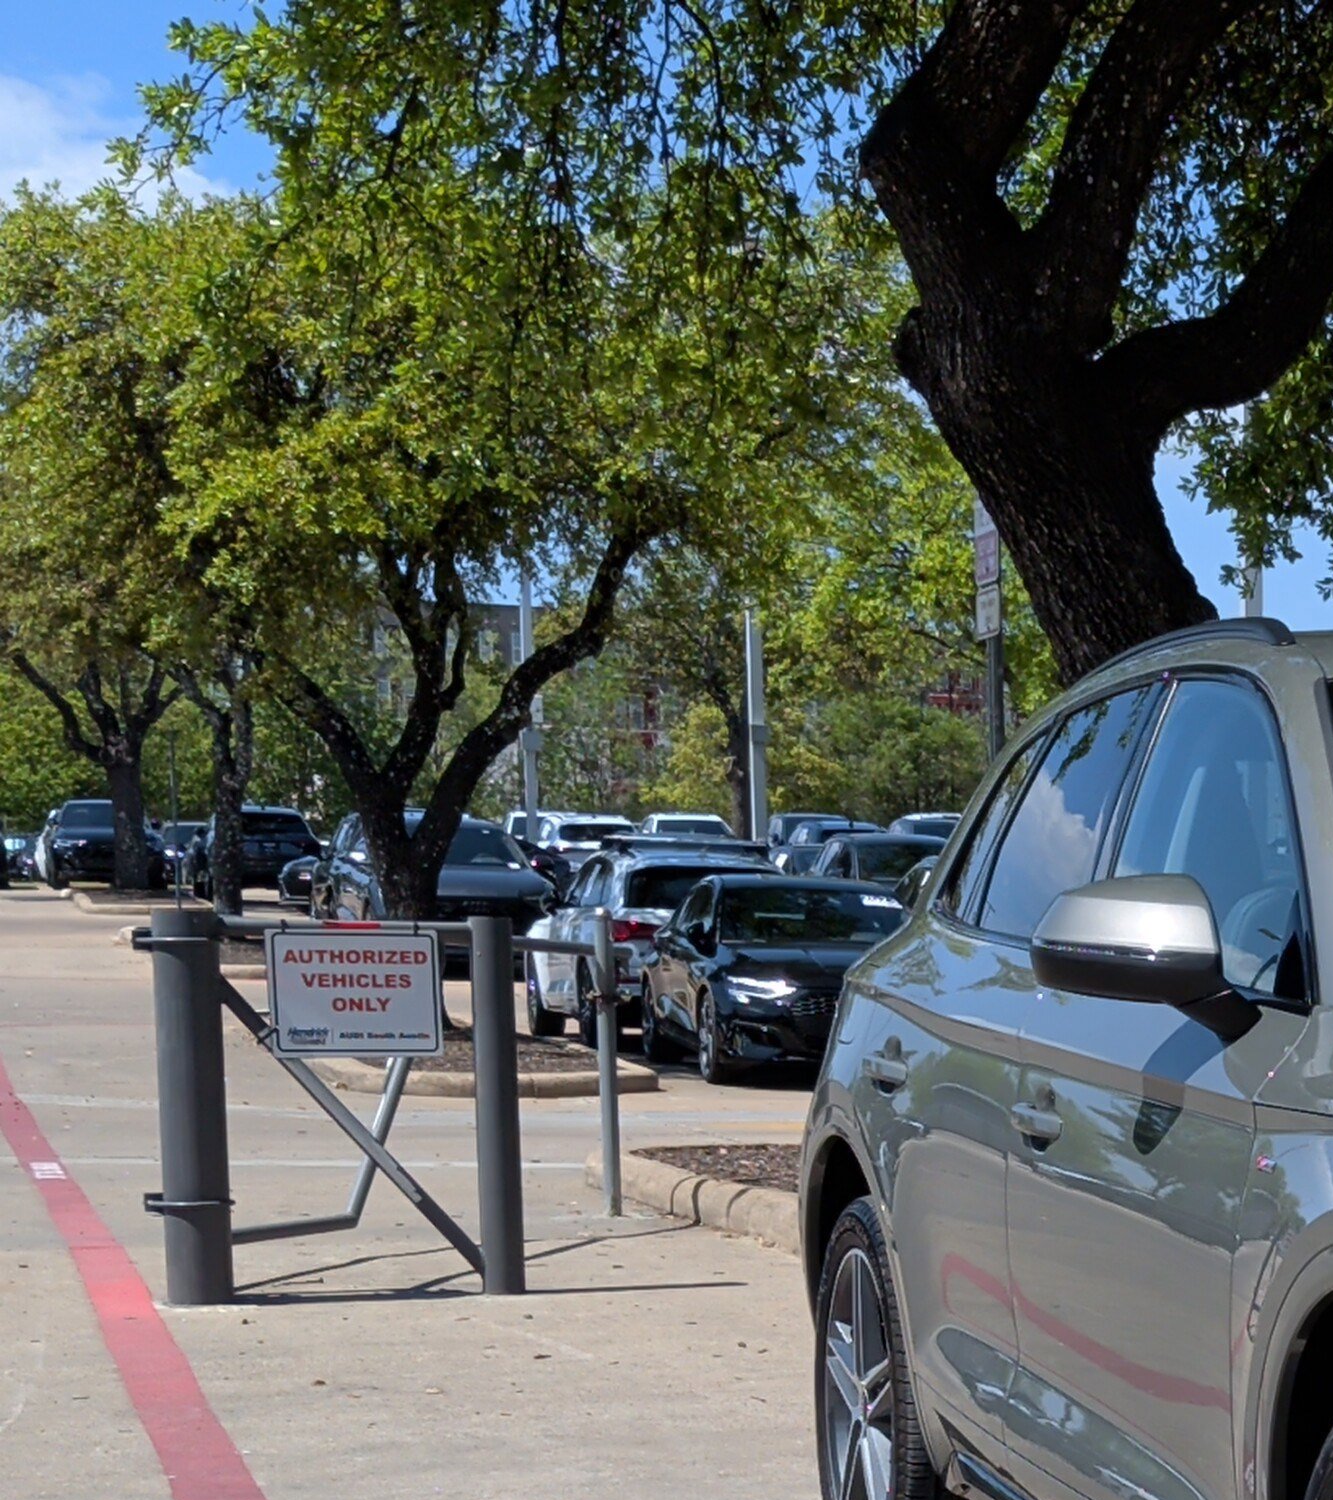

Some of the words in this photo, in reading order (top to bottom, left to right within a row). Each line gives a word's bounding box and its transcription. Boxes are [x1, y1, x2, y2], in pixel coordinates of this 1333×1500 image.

[283, 949, 428, 965] AUTHORIZED
[302, 973, 412, 988] VEHICLES
[332, 997, 391, 1012] ONLY
